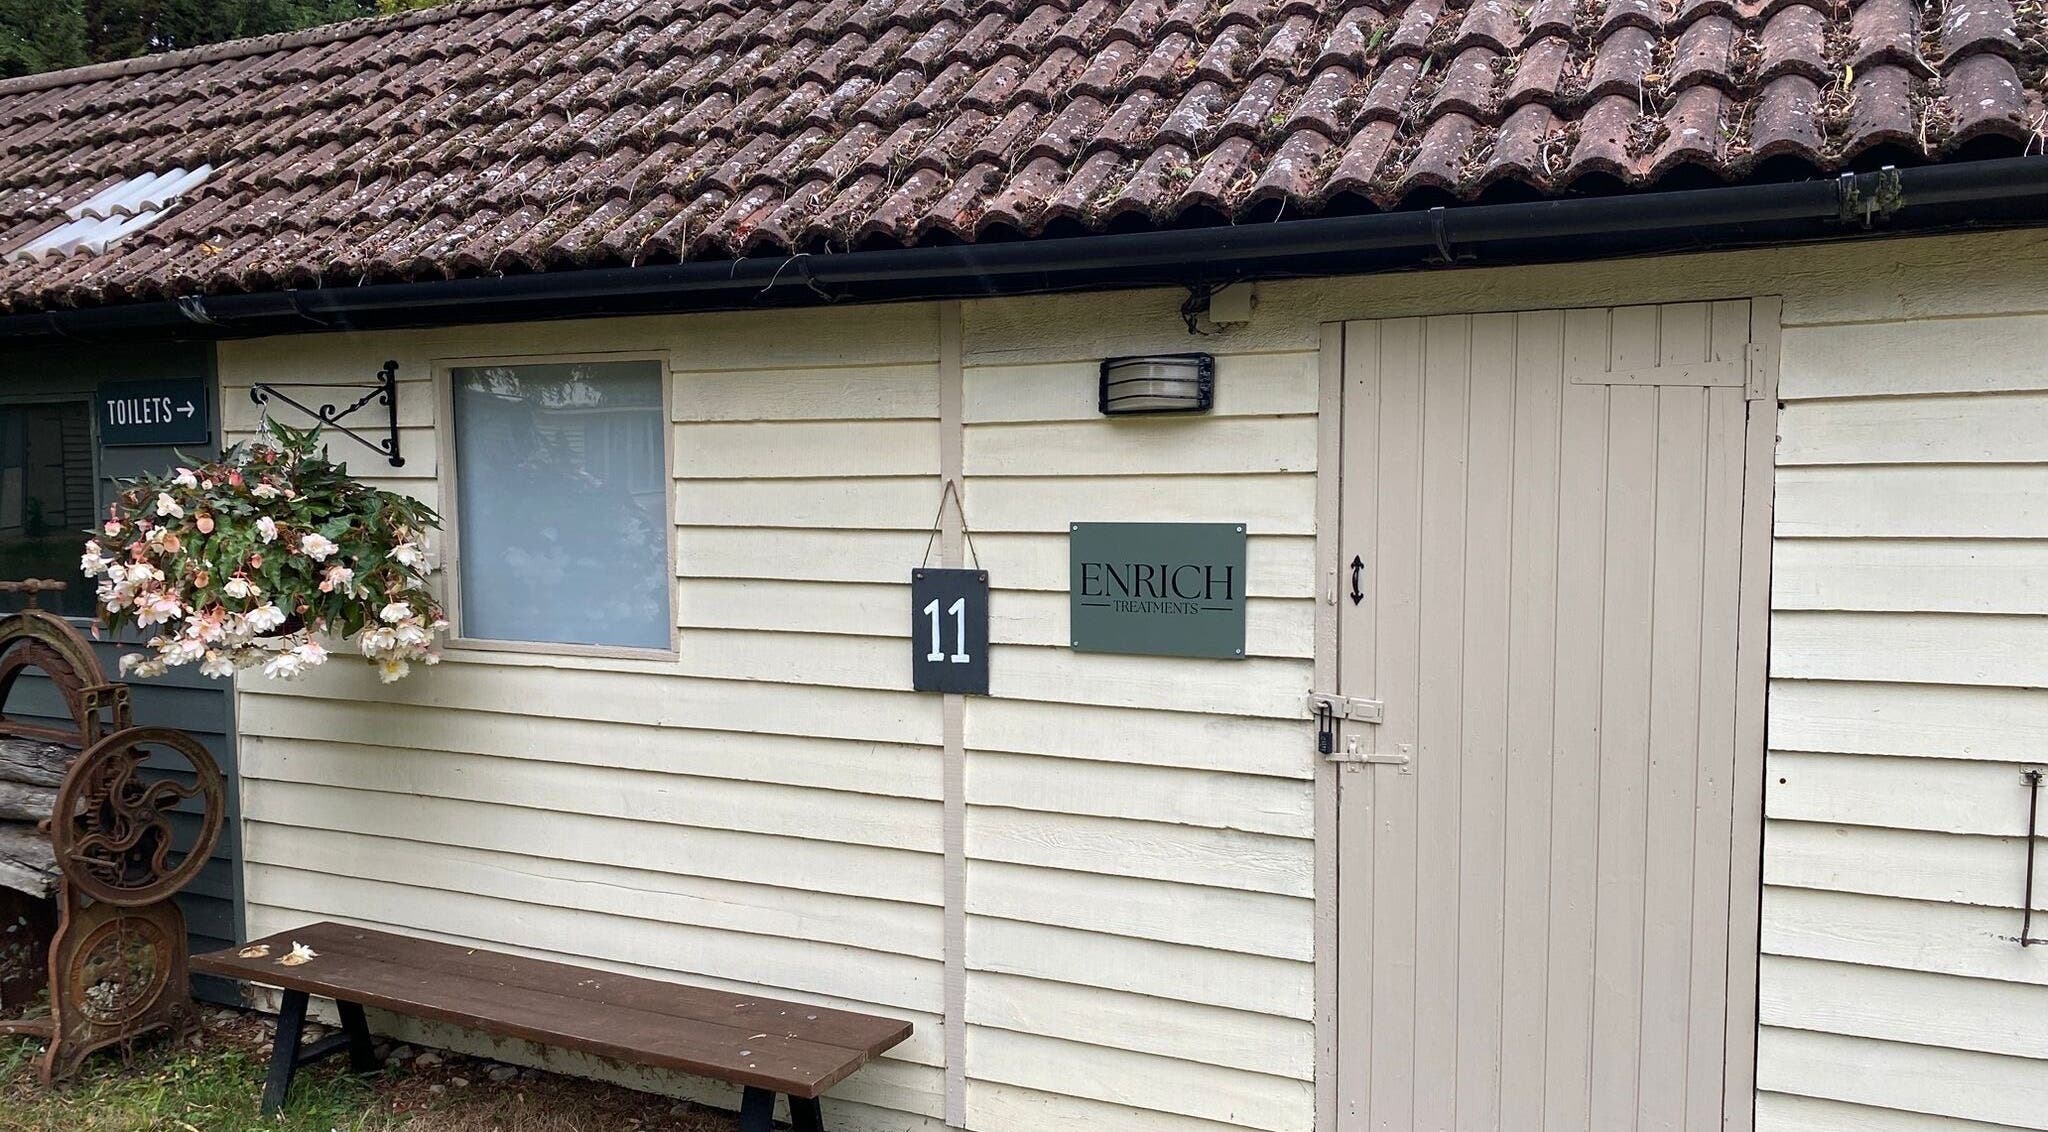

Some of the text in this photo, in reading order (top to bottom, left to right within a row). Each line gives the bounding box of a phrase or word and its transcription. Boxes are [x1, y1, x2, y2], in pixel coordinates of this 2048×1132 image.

[107, 397, 172, 425] TOILETS
[1080, 562, 1234, 600] ENRICH
[1113, 599, 1199, 615] TREATMENTS
[923, 597, 970, 663] 11
